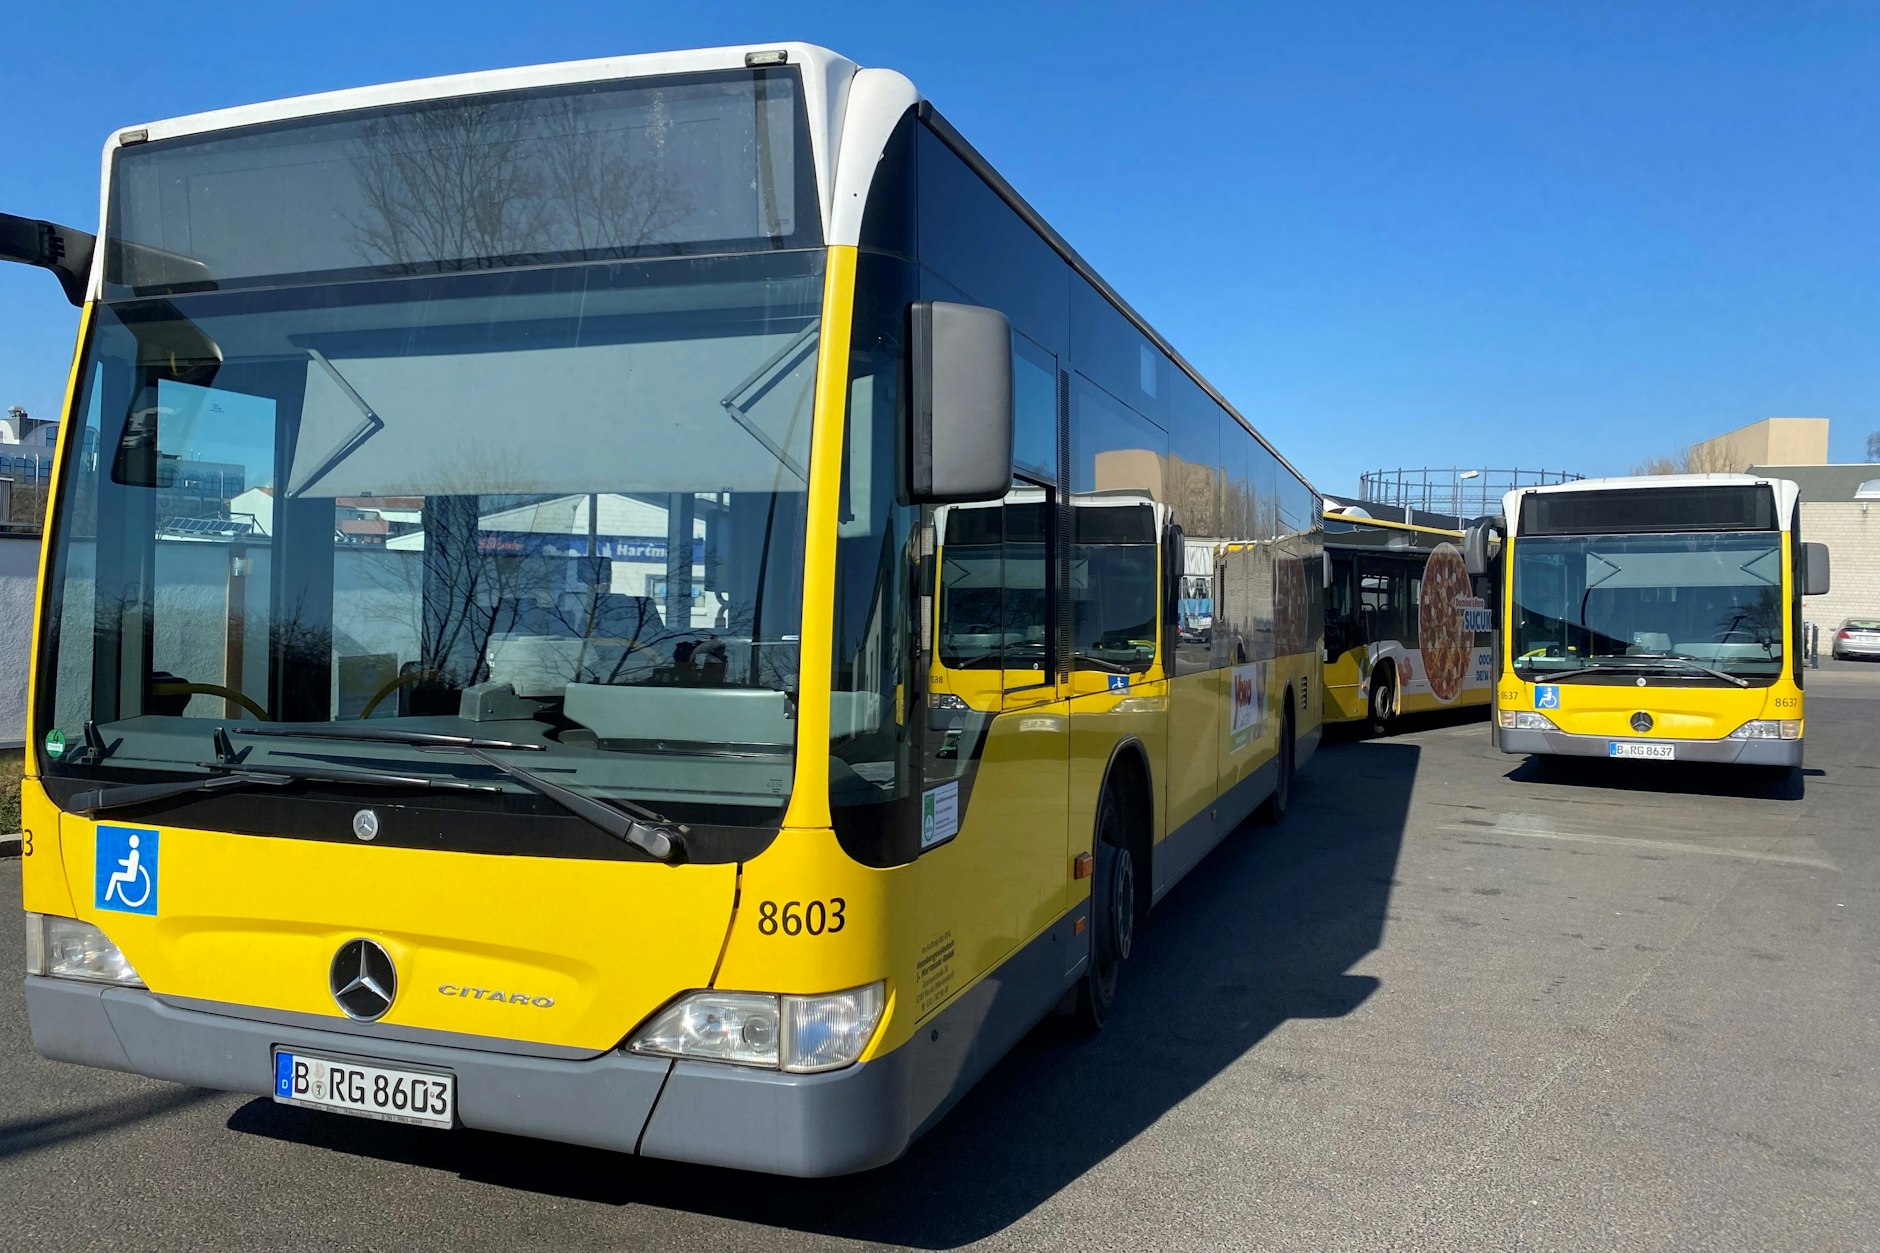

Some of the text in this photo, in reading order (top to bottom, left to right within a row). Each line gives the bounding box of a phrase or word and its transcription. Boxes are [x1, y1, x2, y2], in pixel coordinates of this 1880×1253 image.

[616, 543, 668, 558] Hartm
[1464, 610, 1491, 631] SUCUK
[1501, 691, 1518, 700] 8637
[1775, 697, 1797, 707] 8637
[1617, 745, 1673, 756] B RG 8637
[758, 897, 846, 936] 8603
[438, 984, 555, 1008] CITARO
[281, 1061, 447, 1115] D B RG 8603
